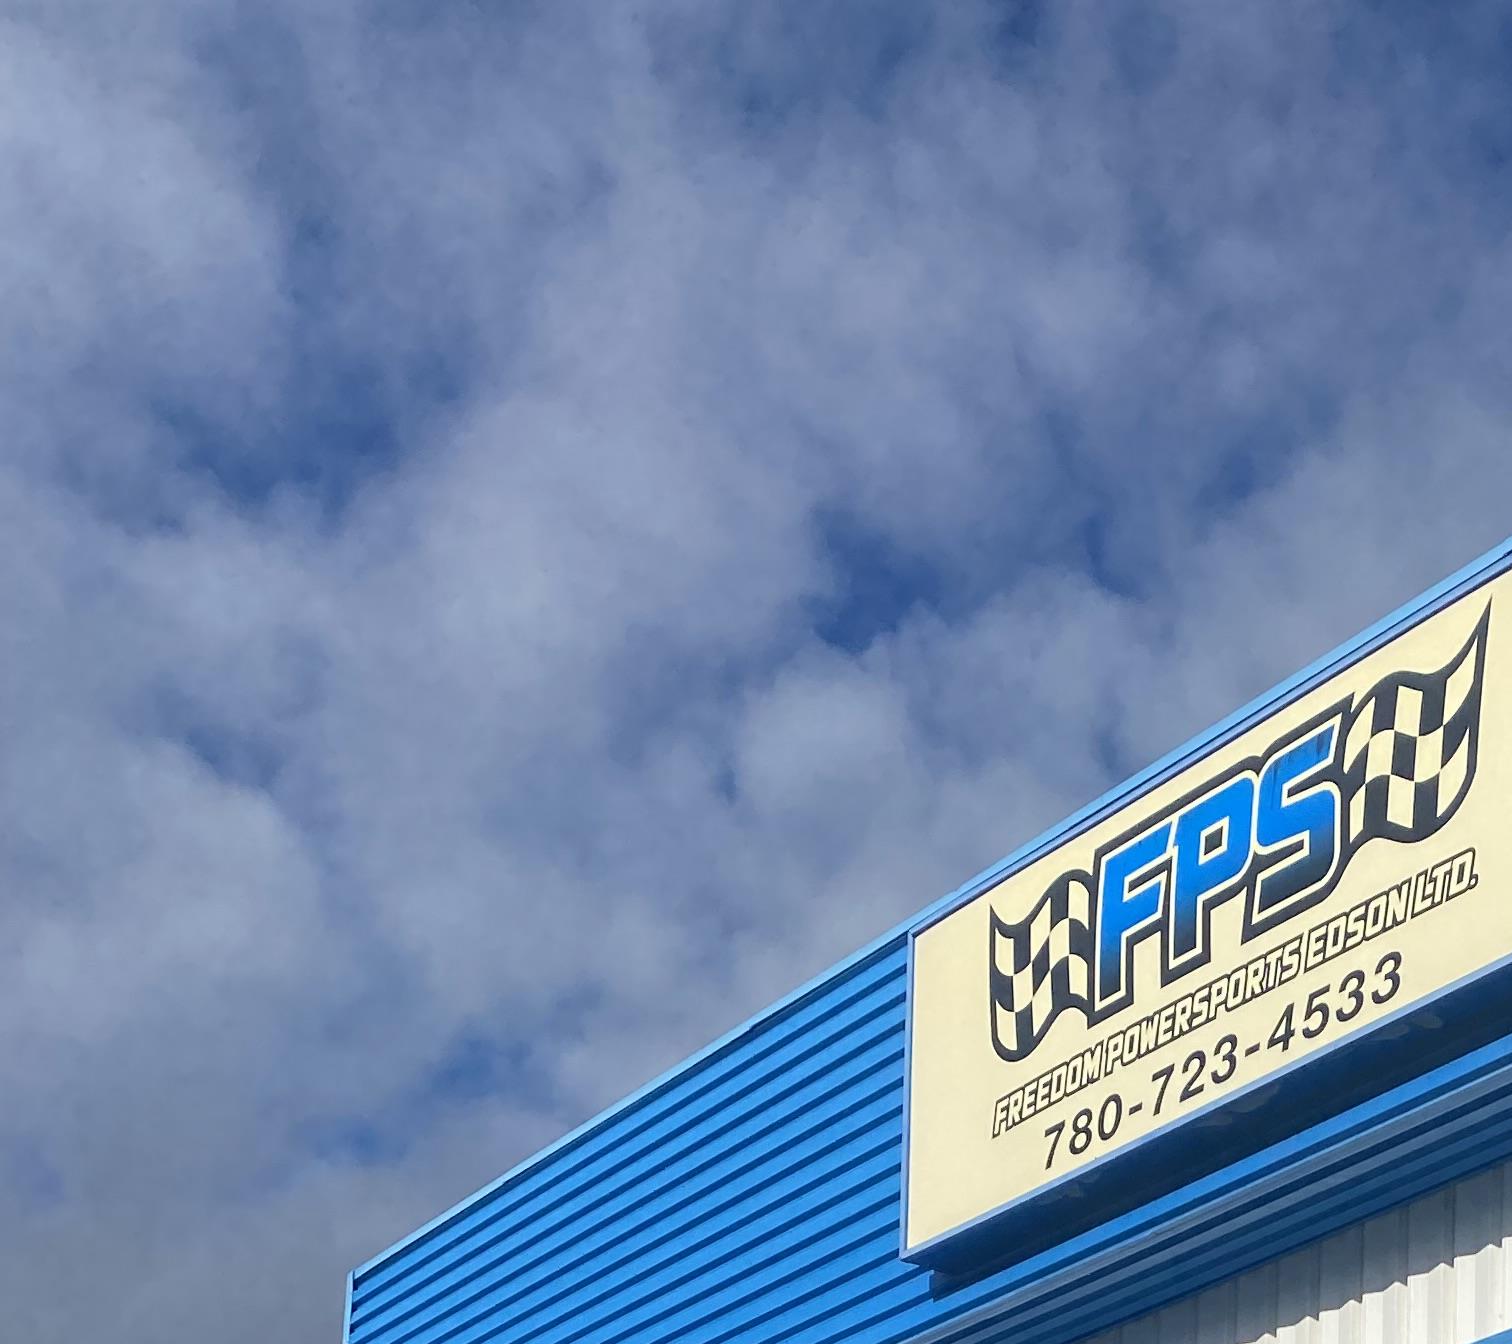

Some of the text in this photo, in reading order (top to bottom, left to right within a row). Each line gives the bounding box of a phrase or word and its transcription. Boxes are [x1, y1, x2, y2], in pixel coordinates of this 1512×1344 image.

[992, 847, 1479, 1138] FREEDOM POWERSPORTS EDSON LTD.
[1096, 704, 1346, 1014] FPS
[1044, 951, 1402, 1170] 780-723-4533
